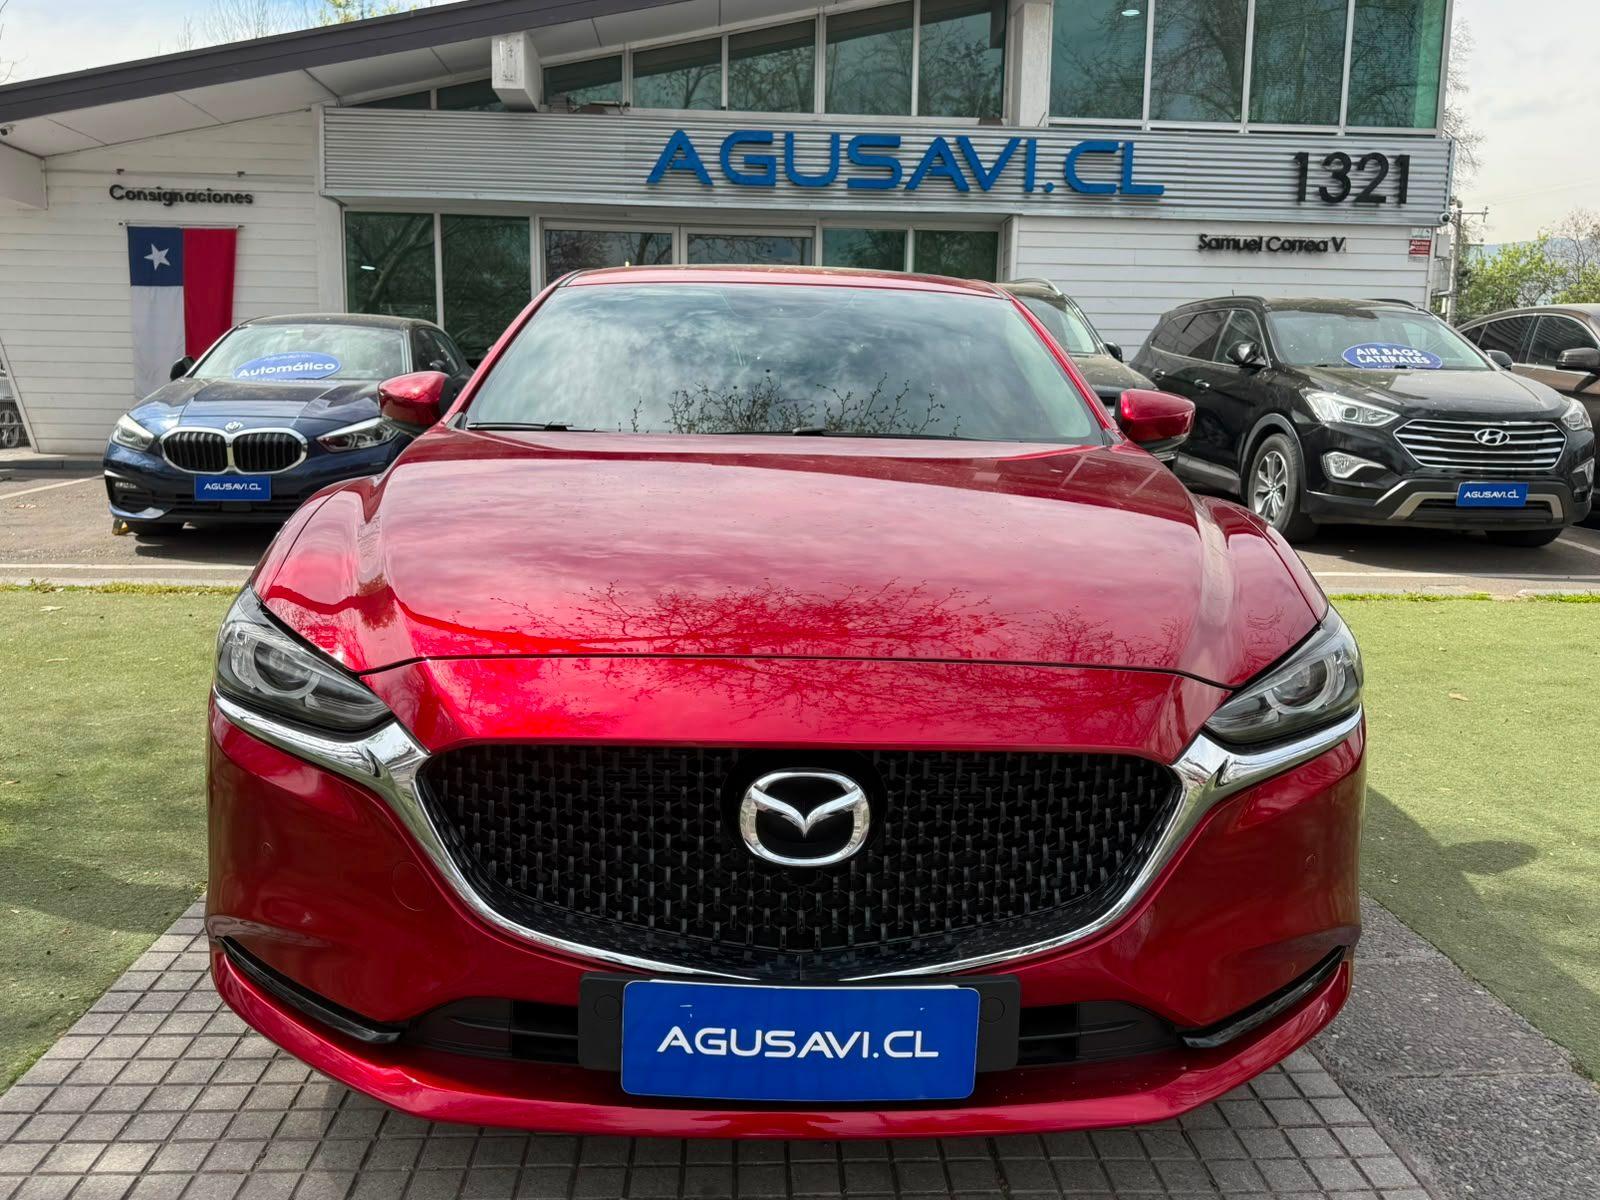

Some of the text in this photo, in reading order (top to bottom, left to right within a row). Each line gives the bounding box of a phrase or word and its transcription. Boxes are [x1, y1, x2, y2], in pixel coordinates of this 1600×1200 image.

[646, 129, 1164, 196] AGUSAVI.CL
[1293, 151, 1411, 204] 1321
[109, 184, 254, 207] Consignaciones
[1198, 233, 1263, 252] Samuel
[1266, 236, 1328, 253] Correa
[1356, 348, 1422, 356] AIR BAGS
[1357, 355, 1431, 365] LATERALES
[237, 362, 336, 378] Automático
[204, 483, 262, 491] AGUSAVI.CL
[1463, 489, 1520, 499] AGUSAVI.CL
[656, 1025, 939, 1059] AGUSAVI.CL
